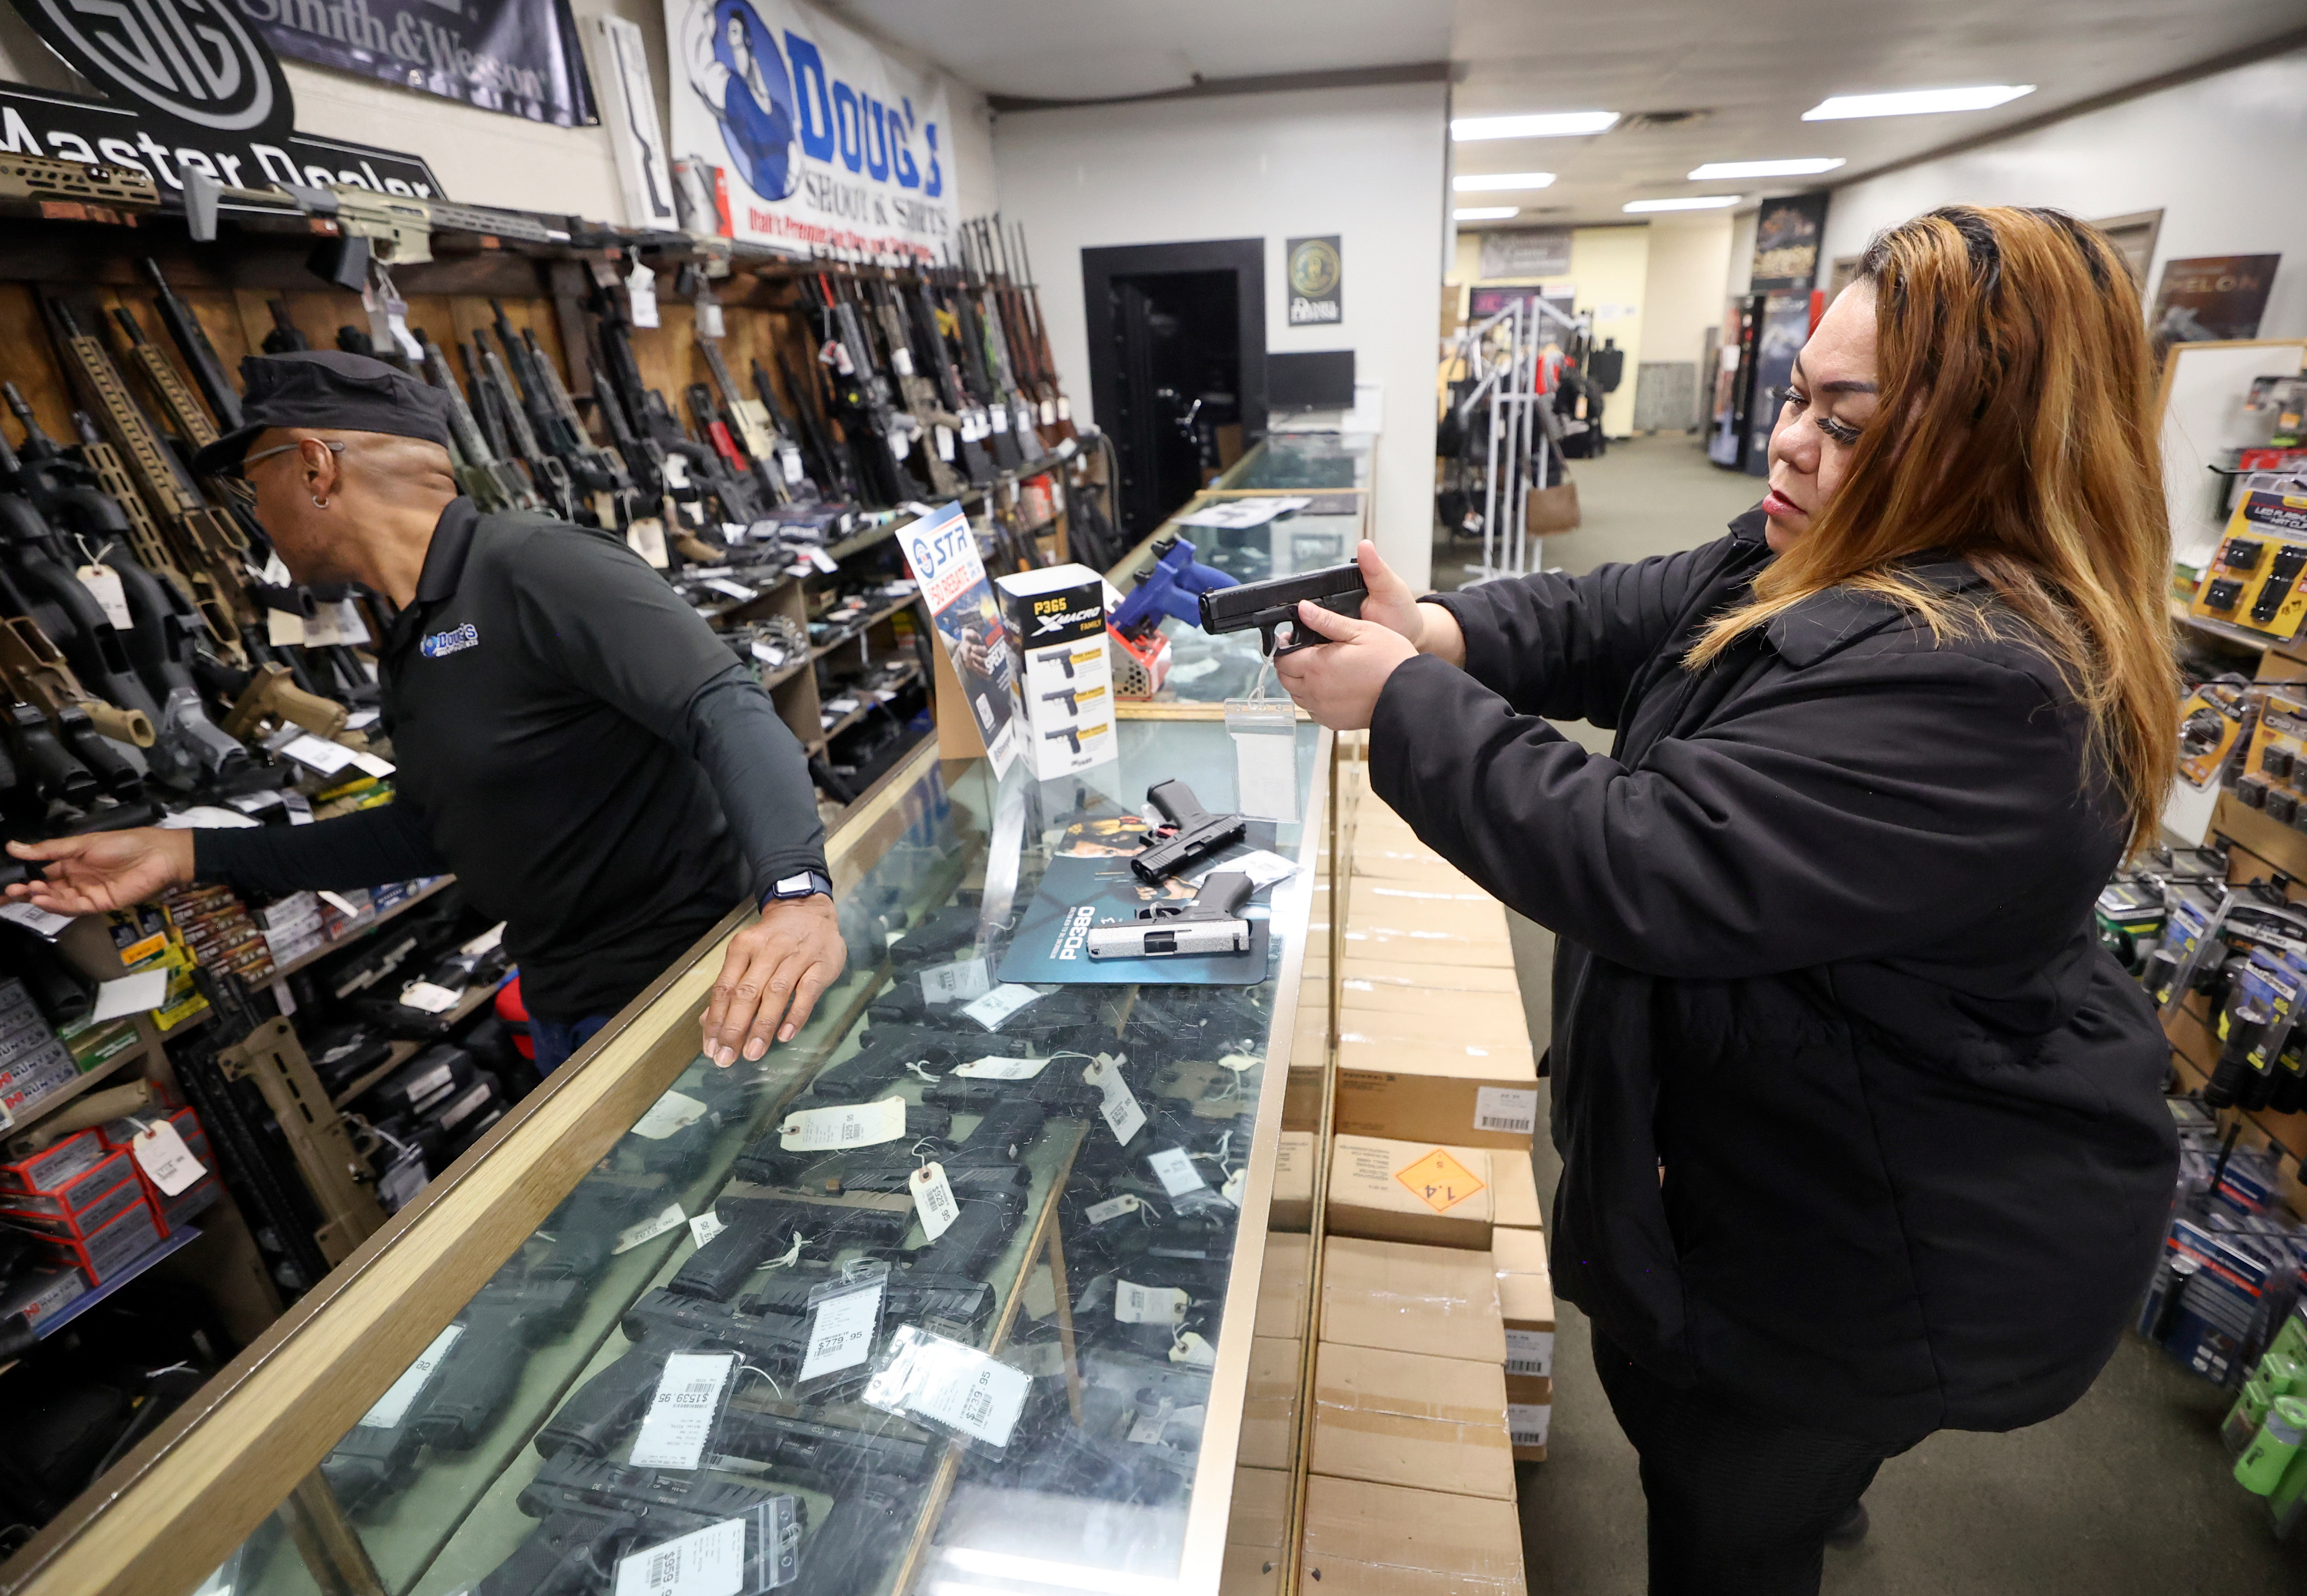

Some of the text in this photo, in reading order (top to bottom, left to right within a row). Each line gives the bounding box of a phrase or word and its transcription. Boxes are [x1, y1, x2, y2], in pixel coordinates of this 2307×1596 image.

[934, 525, 967, 566] STR
[942, 565, 970, 598] REBATE
[1034, 597, 1067, 616] P365
[1080, 619, 1102, 631] FAMILY
[1059, 906, 1095, 959] PD380
[932, 1185, 951, 1222] $929.95
[1425, 1184, 1456, 1202] 1.4
[701, 1221, 714, 1242] 19.95
[817, 1331, 863, 1350] $779.95
[658, 1393, 709, 1403] $1539.95
[966, 1371, 991, 1421] $739.95
